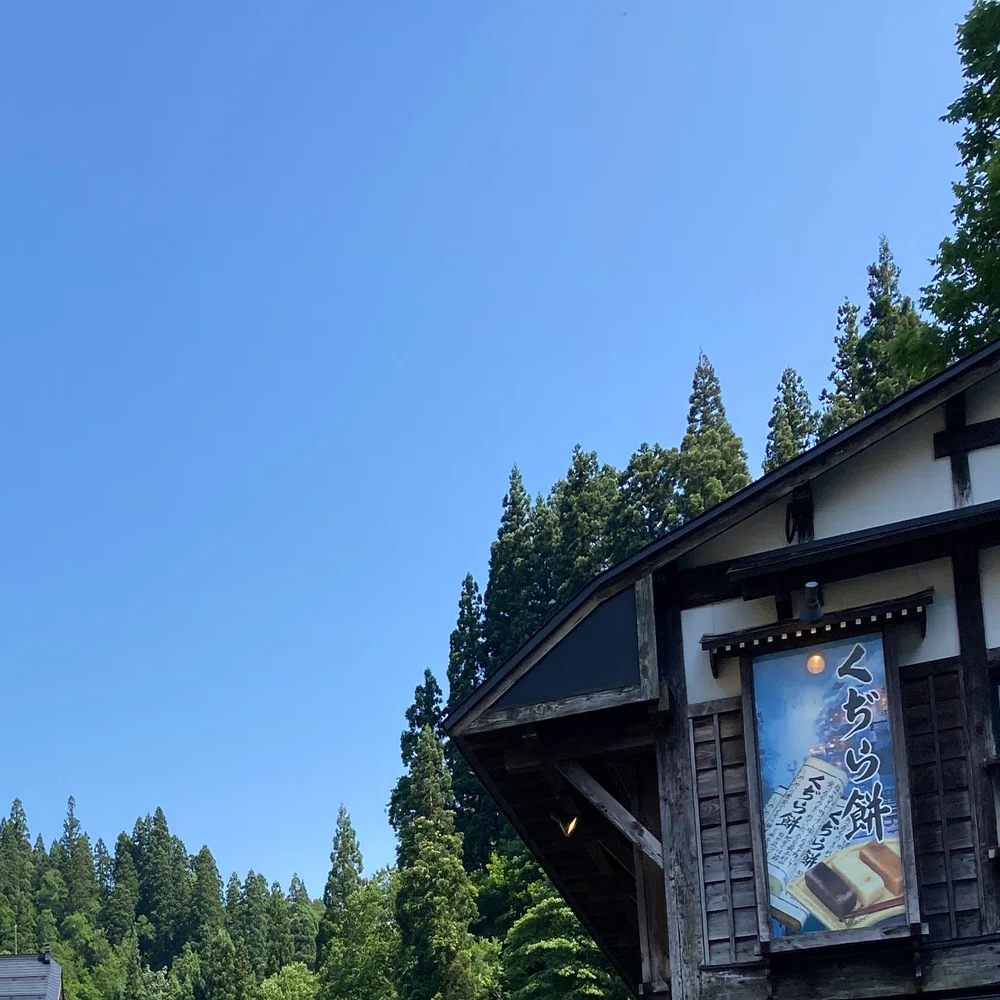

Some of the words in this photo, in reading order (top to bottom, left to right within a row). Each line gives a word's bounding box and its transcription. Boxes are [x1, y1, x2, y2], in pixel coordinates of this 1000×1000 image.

[776, 776, 825, 835] くぢら餅
[837, 643, 892, 843] くぢら餅
